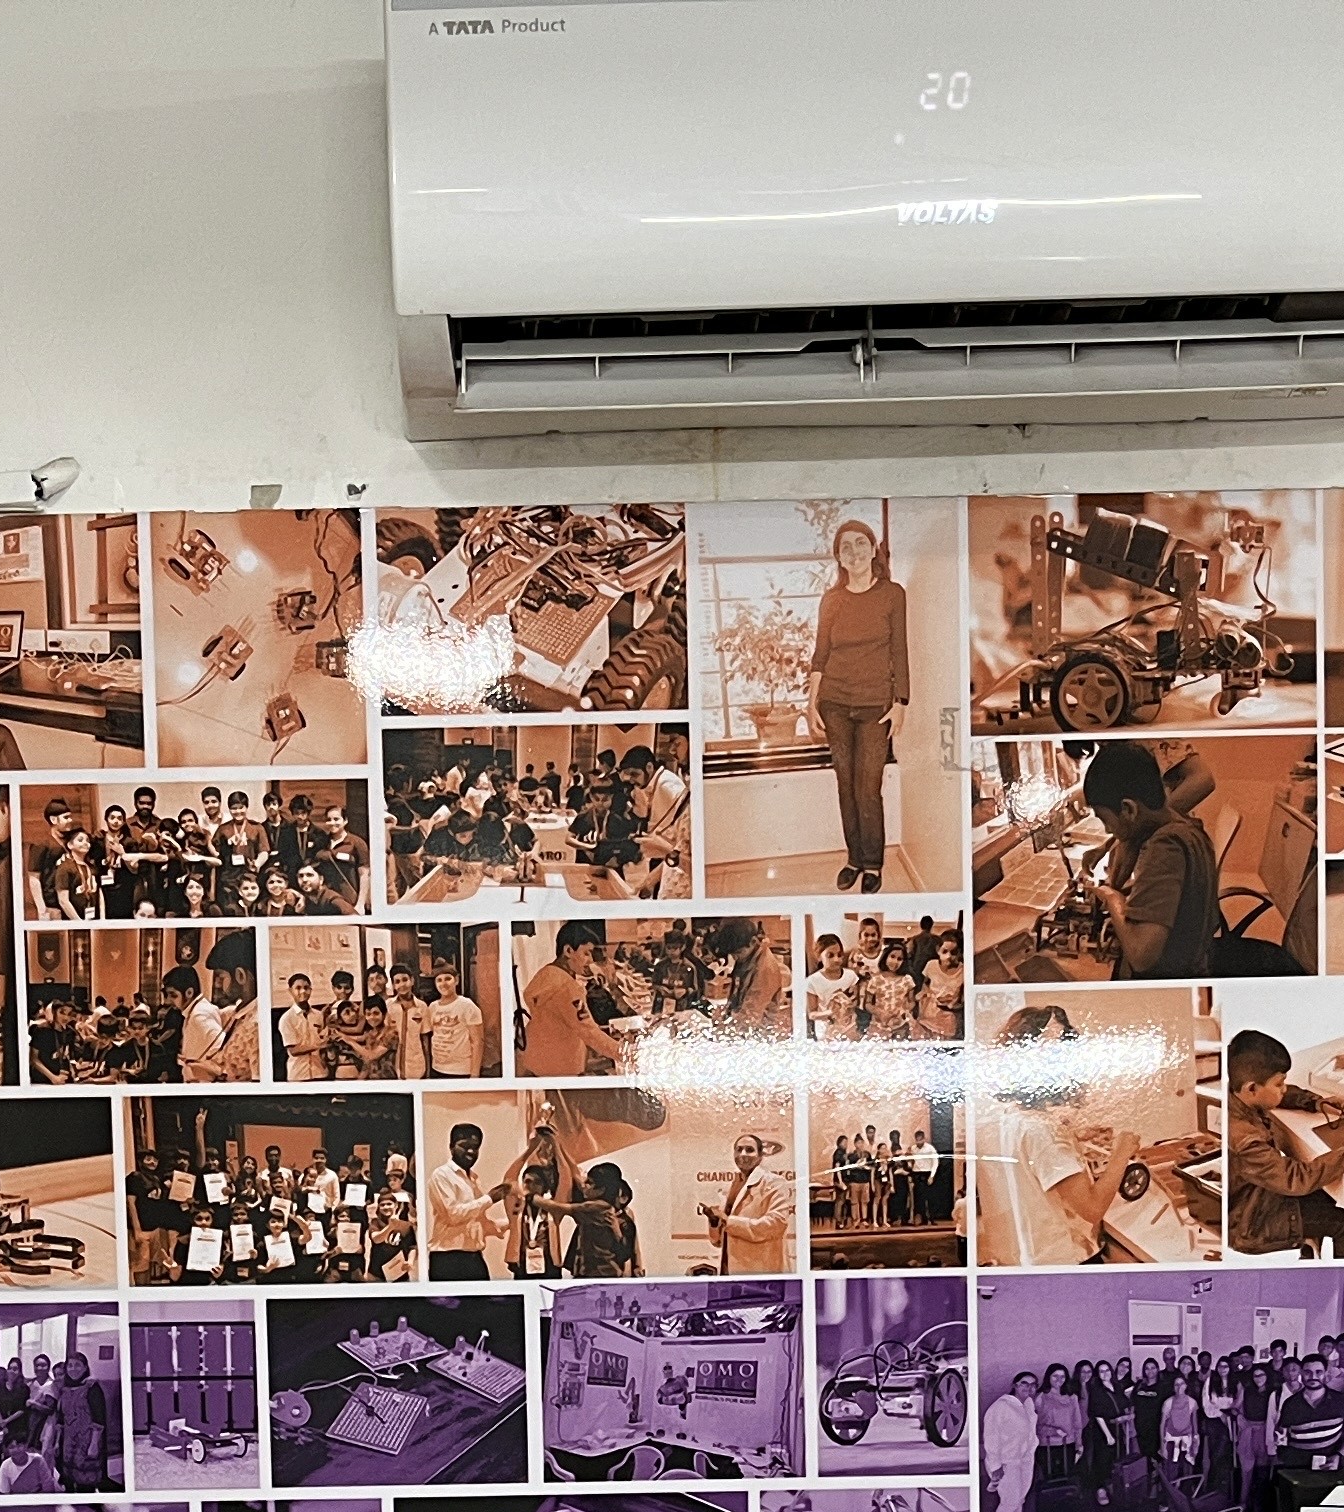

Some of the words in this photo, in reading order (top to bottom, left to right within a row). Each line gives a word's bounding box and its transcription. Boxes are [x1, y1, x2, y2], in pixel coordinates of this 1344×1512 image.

[428, 22, 439, 36] A
[442, 20, 495, 36] TATA
[501, 18, 566, 34] Product
[920, 71, 971, 111] 20
[897, 200, 999, 226] VOLTAS
[699, 1363, 755, 1378] OMO
